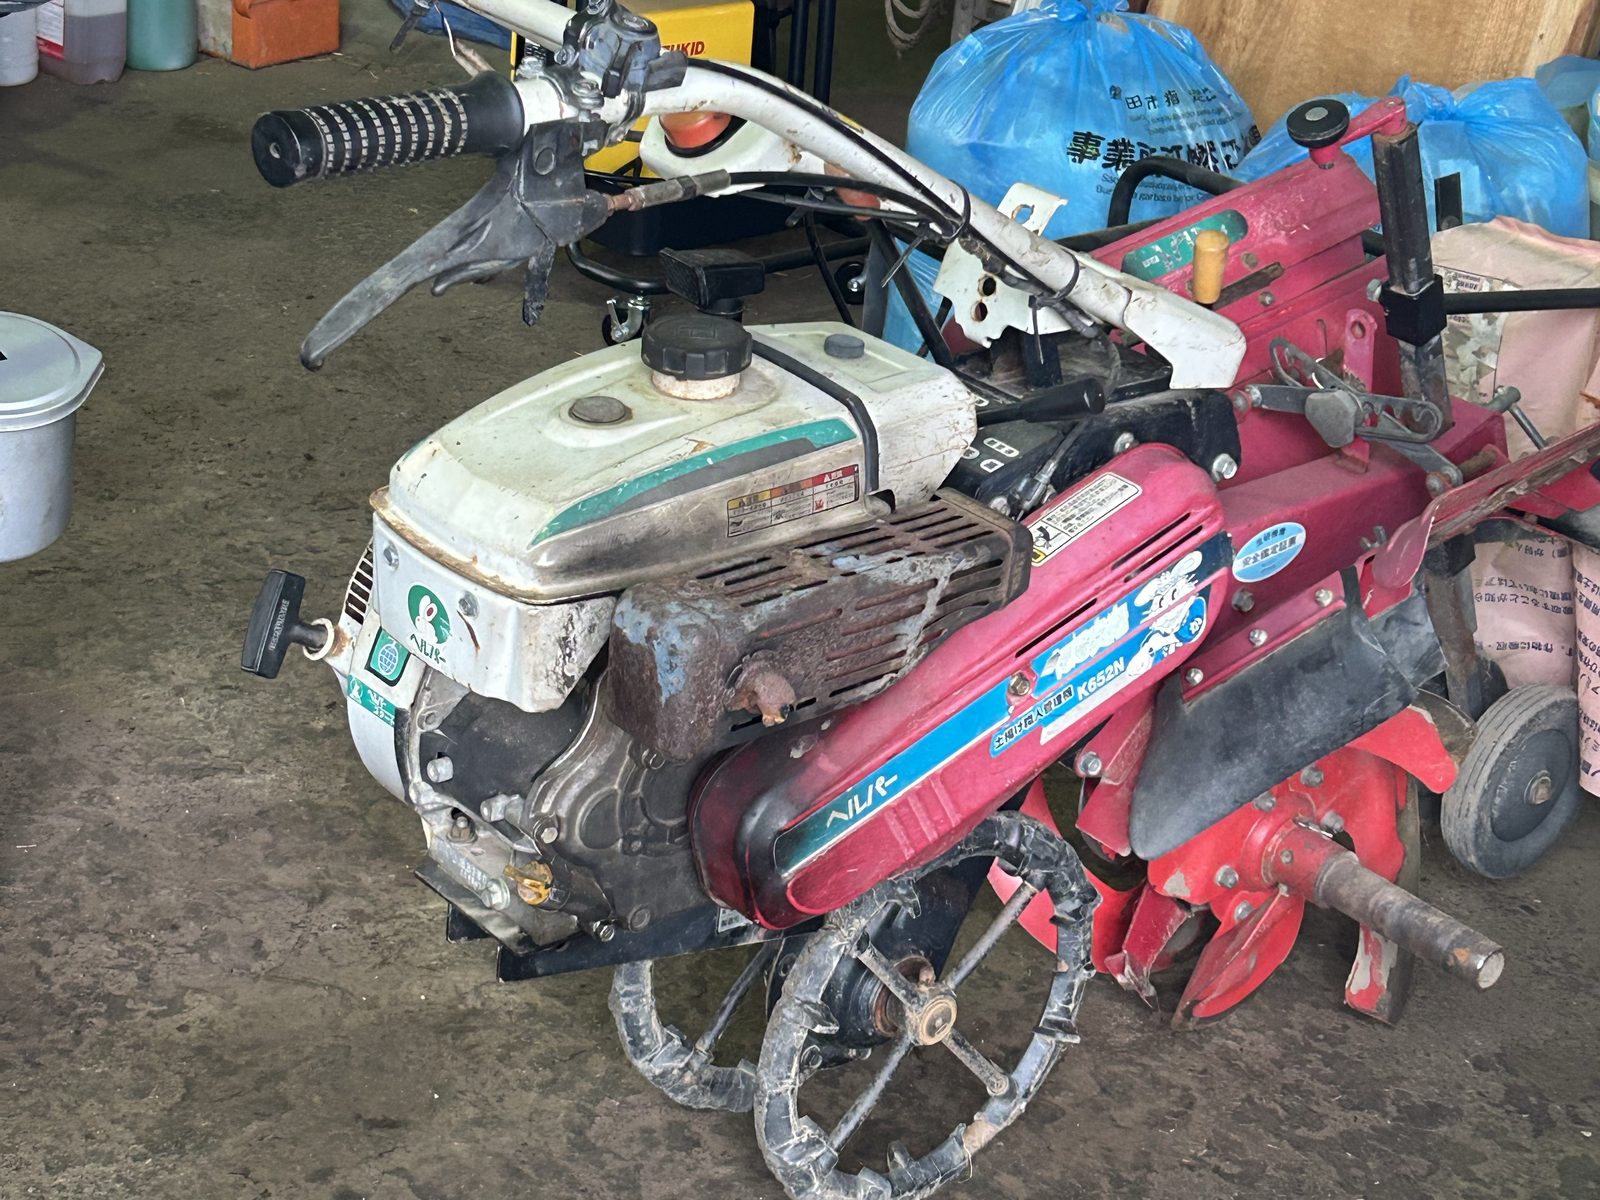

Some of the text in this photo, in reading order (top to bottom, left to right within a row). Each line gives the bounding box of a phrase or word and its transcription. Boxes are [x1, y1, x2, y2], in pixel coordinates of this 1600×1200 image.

[1077, 657, 1126, 701] K652N
[827, 774, 898, 828] ヘルパー
